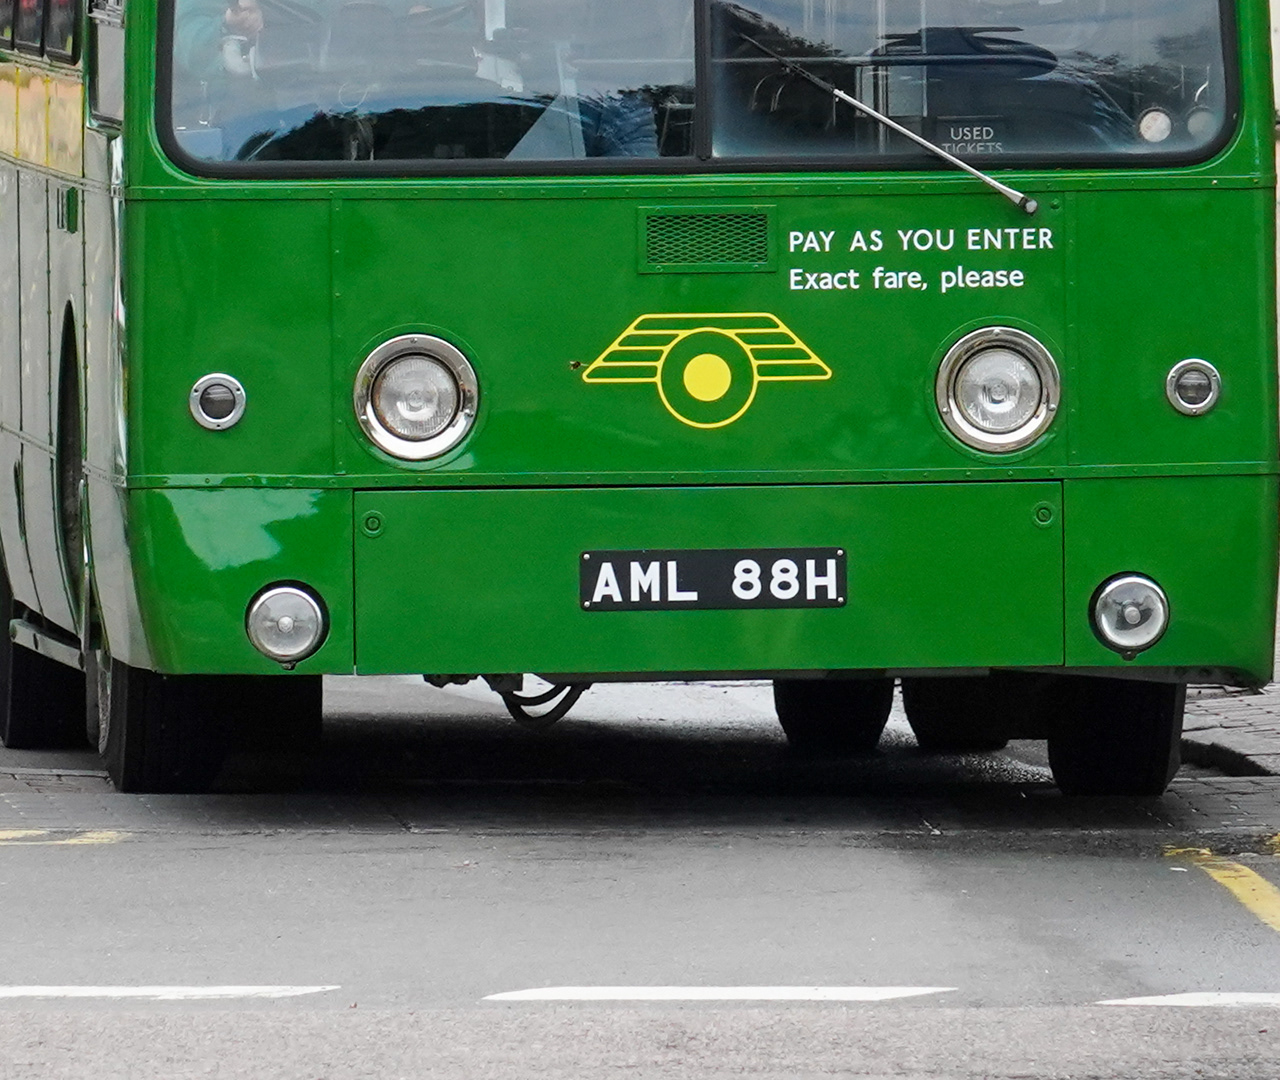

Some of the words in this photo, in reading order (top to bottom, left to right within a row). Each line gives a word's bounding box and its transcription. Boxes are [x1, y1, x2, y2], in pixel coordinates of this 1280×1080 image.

[950, 126, 994, 141] USED
[941, 141, 1004, 154] TICKETS
[789, 230, 835, 253] PAY
[849, 229, 883, 252] AS
[897, 229, 954, 251] YOU
[967, 227, 1054, 250] ENTER
[789, 268, 860, 291] Exact
[872, 266, 928, 292] fare,
[941, 265, 1024, 294] please
[592, 561, 698, 603] AML
[732, 558, 838, 602] 88H
